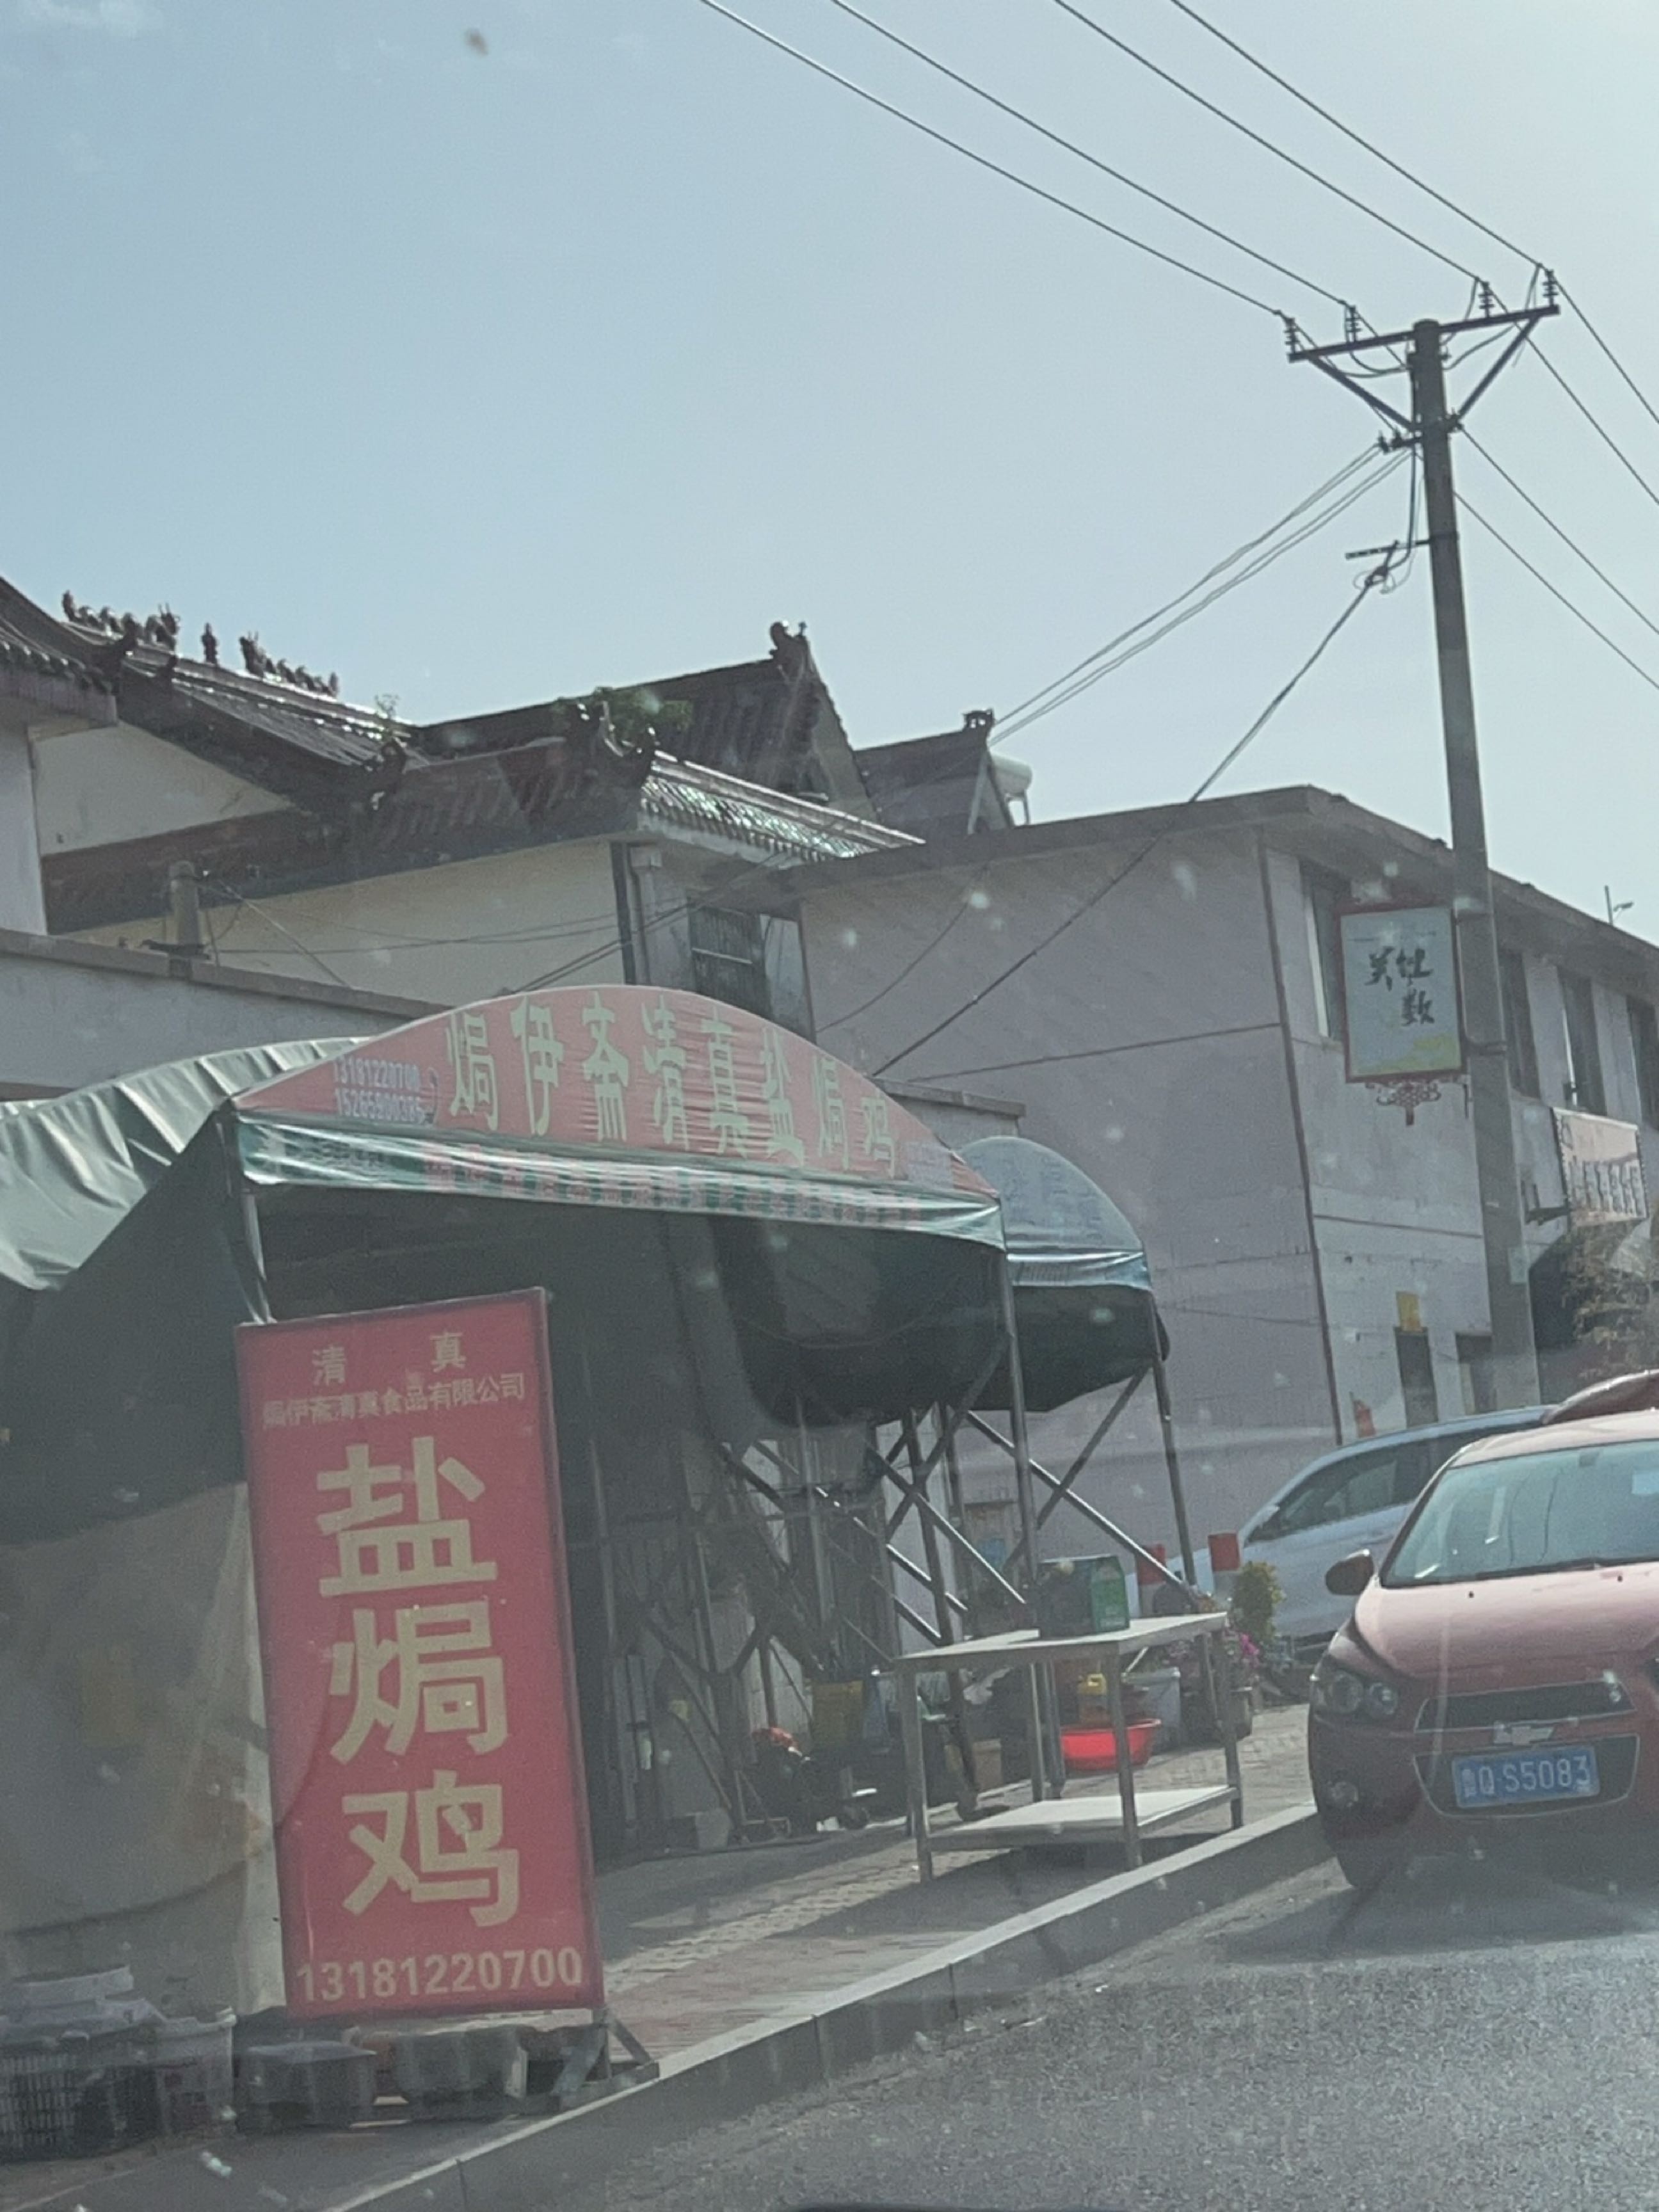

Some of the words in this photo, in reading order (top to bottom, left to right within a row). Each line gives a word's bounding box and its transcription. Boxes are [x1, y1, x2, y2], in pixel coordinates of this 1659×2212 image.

[315, 1436, 520, 1927] 盐焗鸡
[296, 1946, 583, 2003] 13181220700
